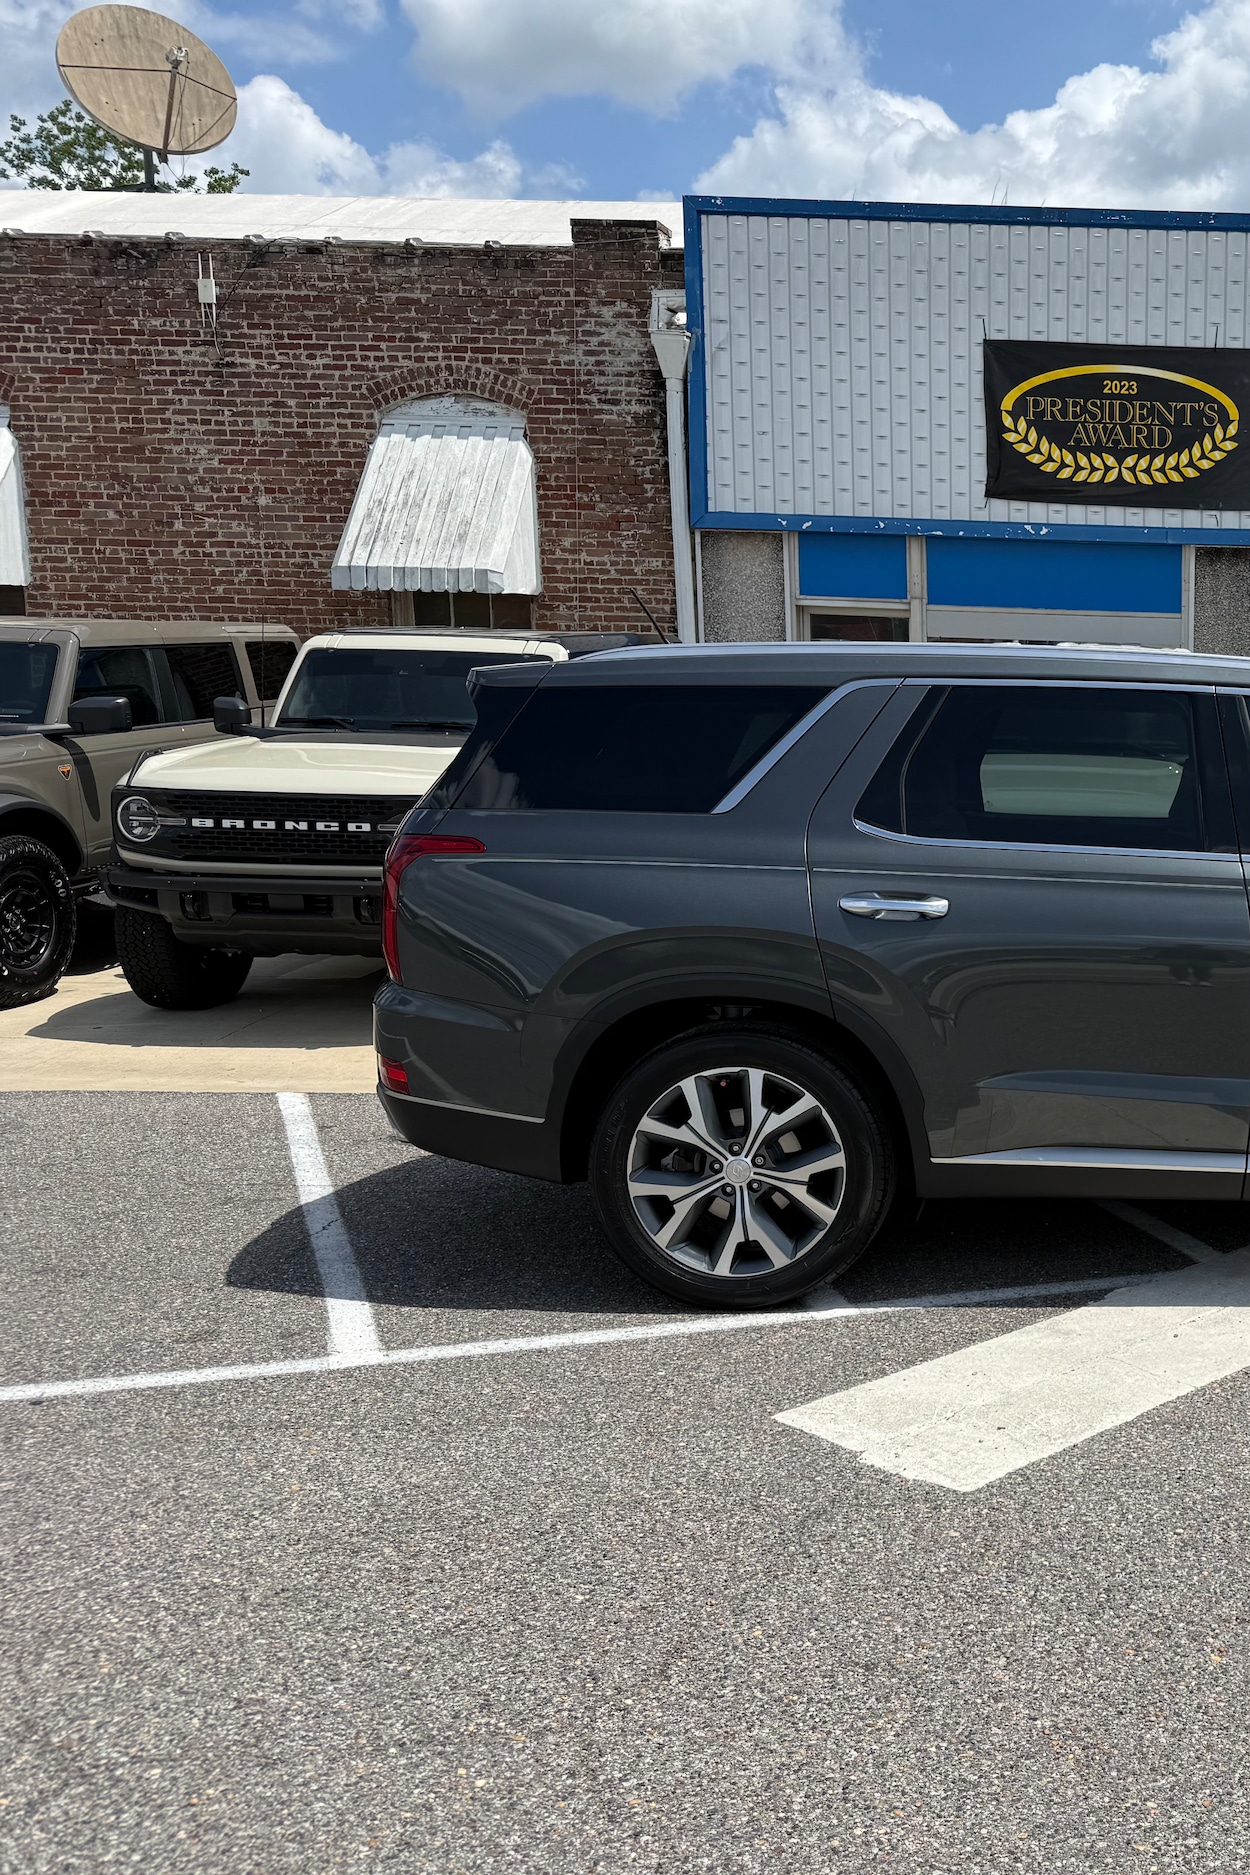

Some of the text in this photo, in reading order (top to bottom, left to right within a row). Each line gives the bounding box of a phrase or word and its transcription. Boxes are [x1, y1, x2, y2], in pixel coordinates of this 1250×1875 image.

[1102, 380, 1138, 394] 2023
[1025, 396, 1219, 427] PRESIDENT'S
[1067, 423, 1173, 449] AWARD
[191, 817, 372, 832] BRONCO
